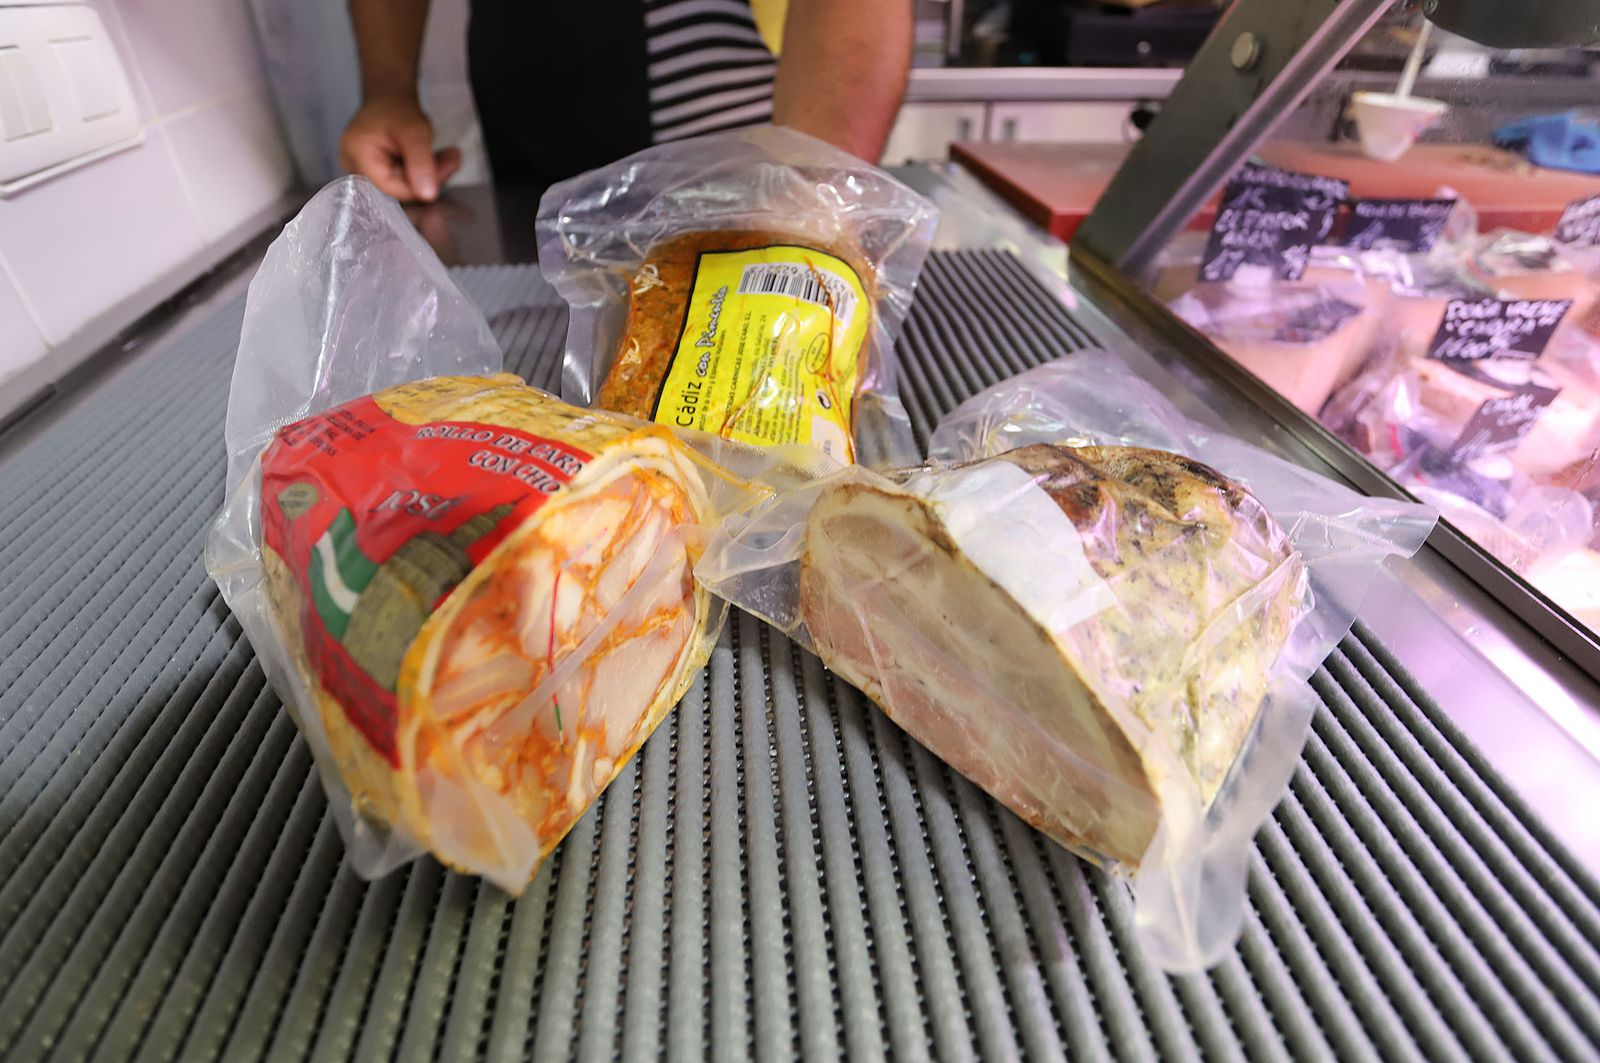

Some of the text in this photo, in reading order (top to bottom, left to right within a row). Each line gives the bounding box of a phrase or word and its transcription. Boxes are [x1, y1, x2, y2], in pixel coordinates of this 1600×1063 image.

[676, 382, 702, 426] Cádiz
[696, 352, 711, 377] con
[414, 425, 494, 441] ROLLO
[492, 433, 531, 454] DE
[468, 450, 561, 495] CON CHO
